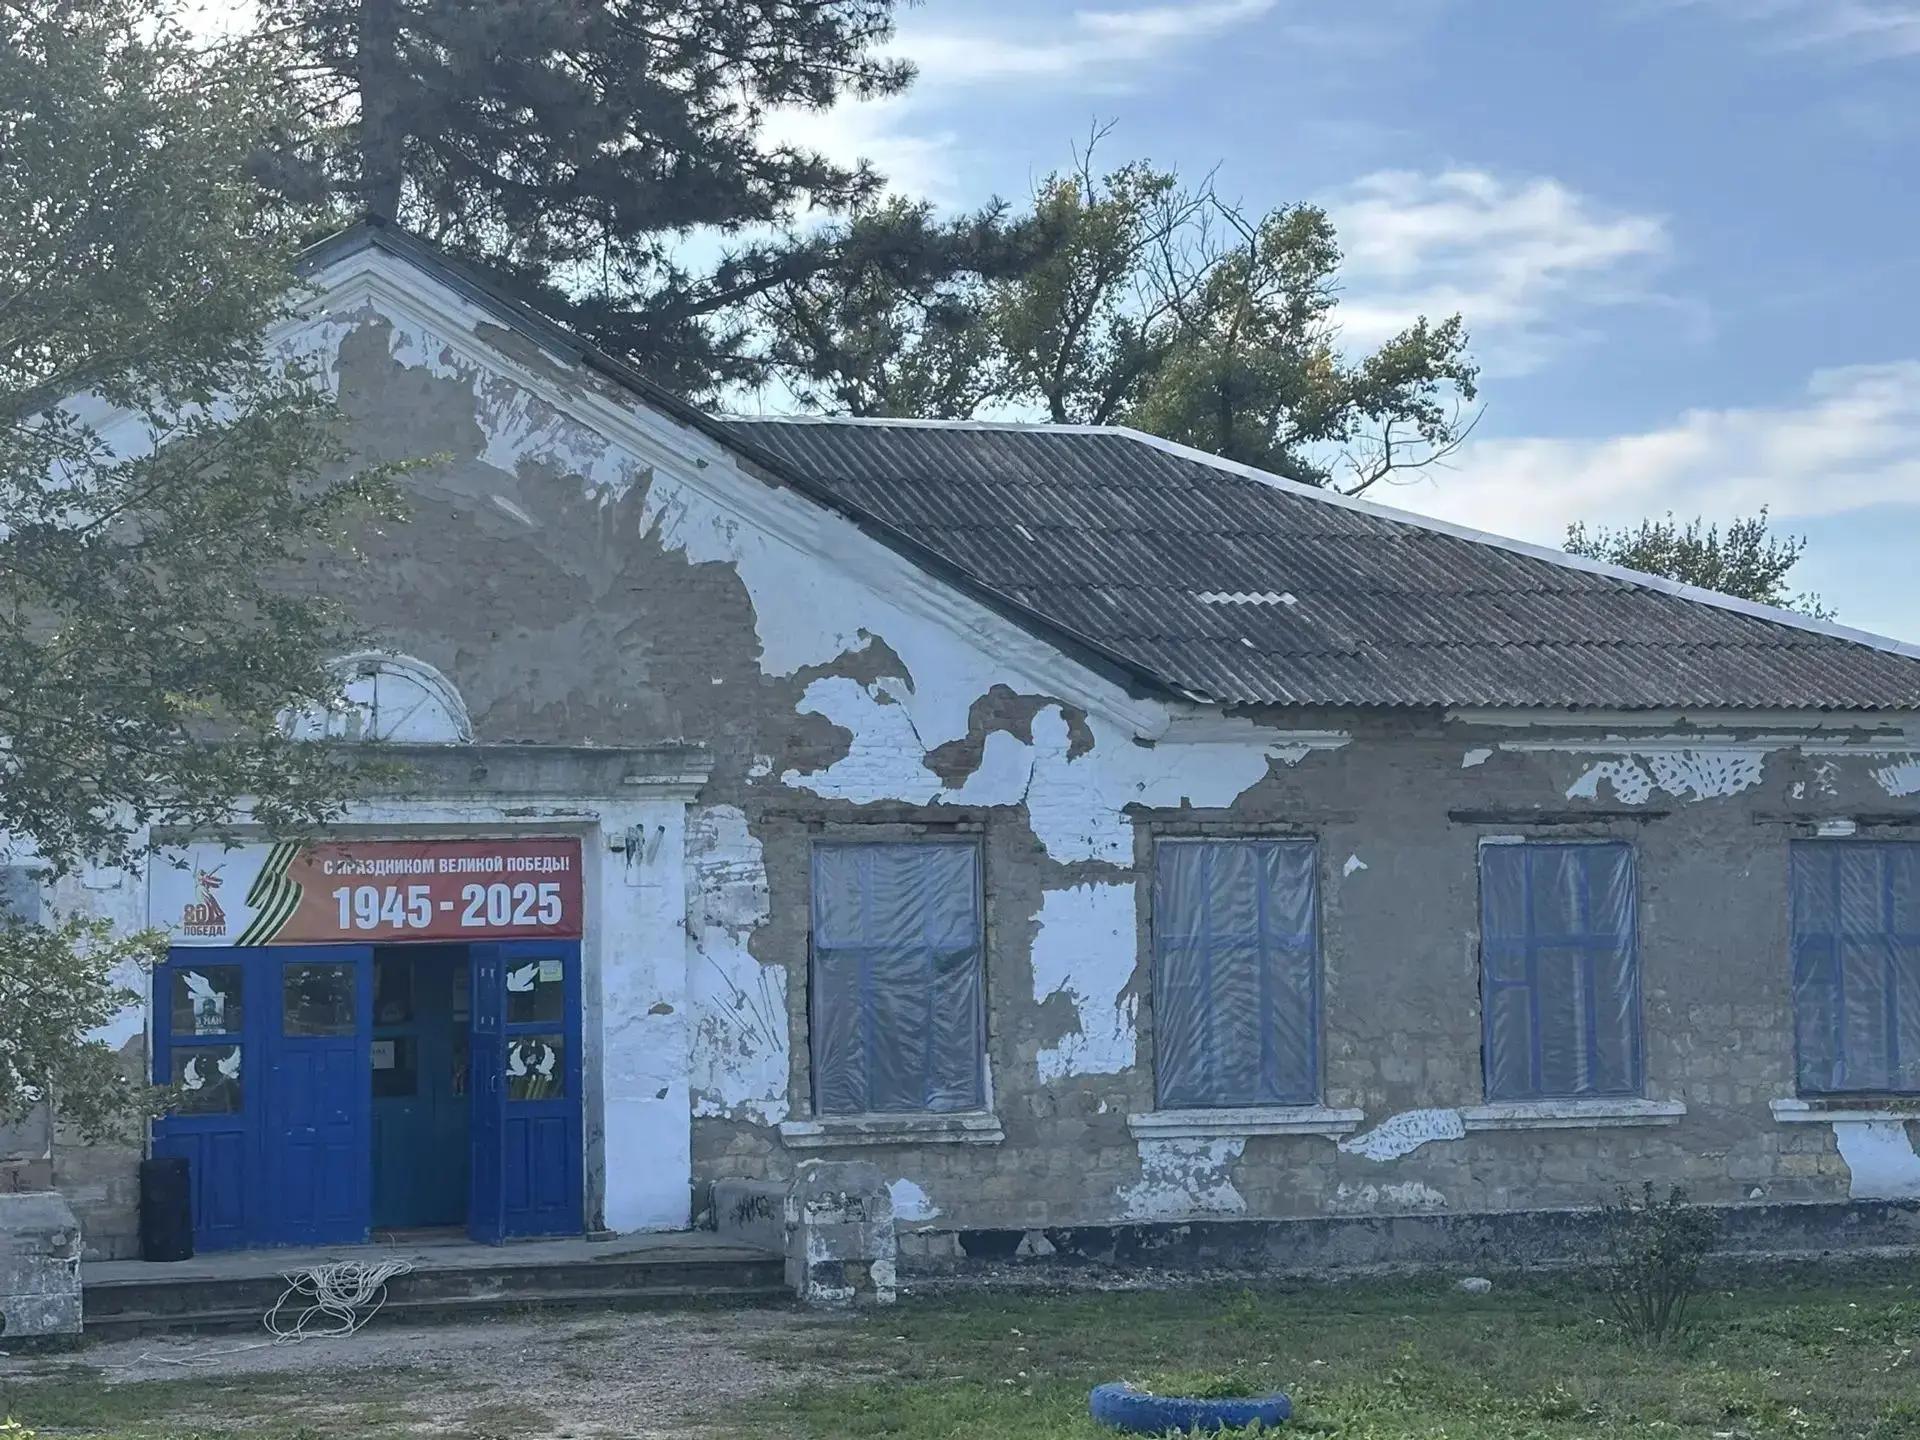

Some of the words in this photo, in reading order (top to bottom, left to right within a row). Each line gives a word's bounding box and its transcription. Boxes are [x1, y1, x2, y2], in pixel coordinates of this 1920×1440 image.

[323, 859, 333, 875] С
[439, 856, 502, 873] ВЕЛИКОЙ
[507, 856, 570, 874] ПОБЕДЫ!
[332, 885, 432, 930] 1945
[440, 901, 454, 911] -
[461, 883, 562, 926] 2025
[184, 926, 226, 937] ПОБЕДА!
